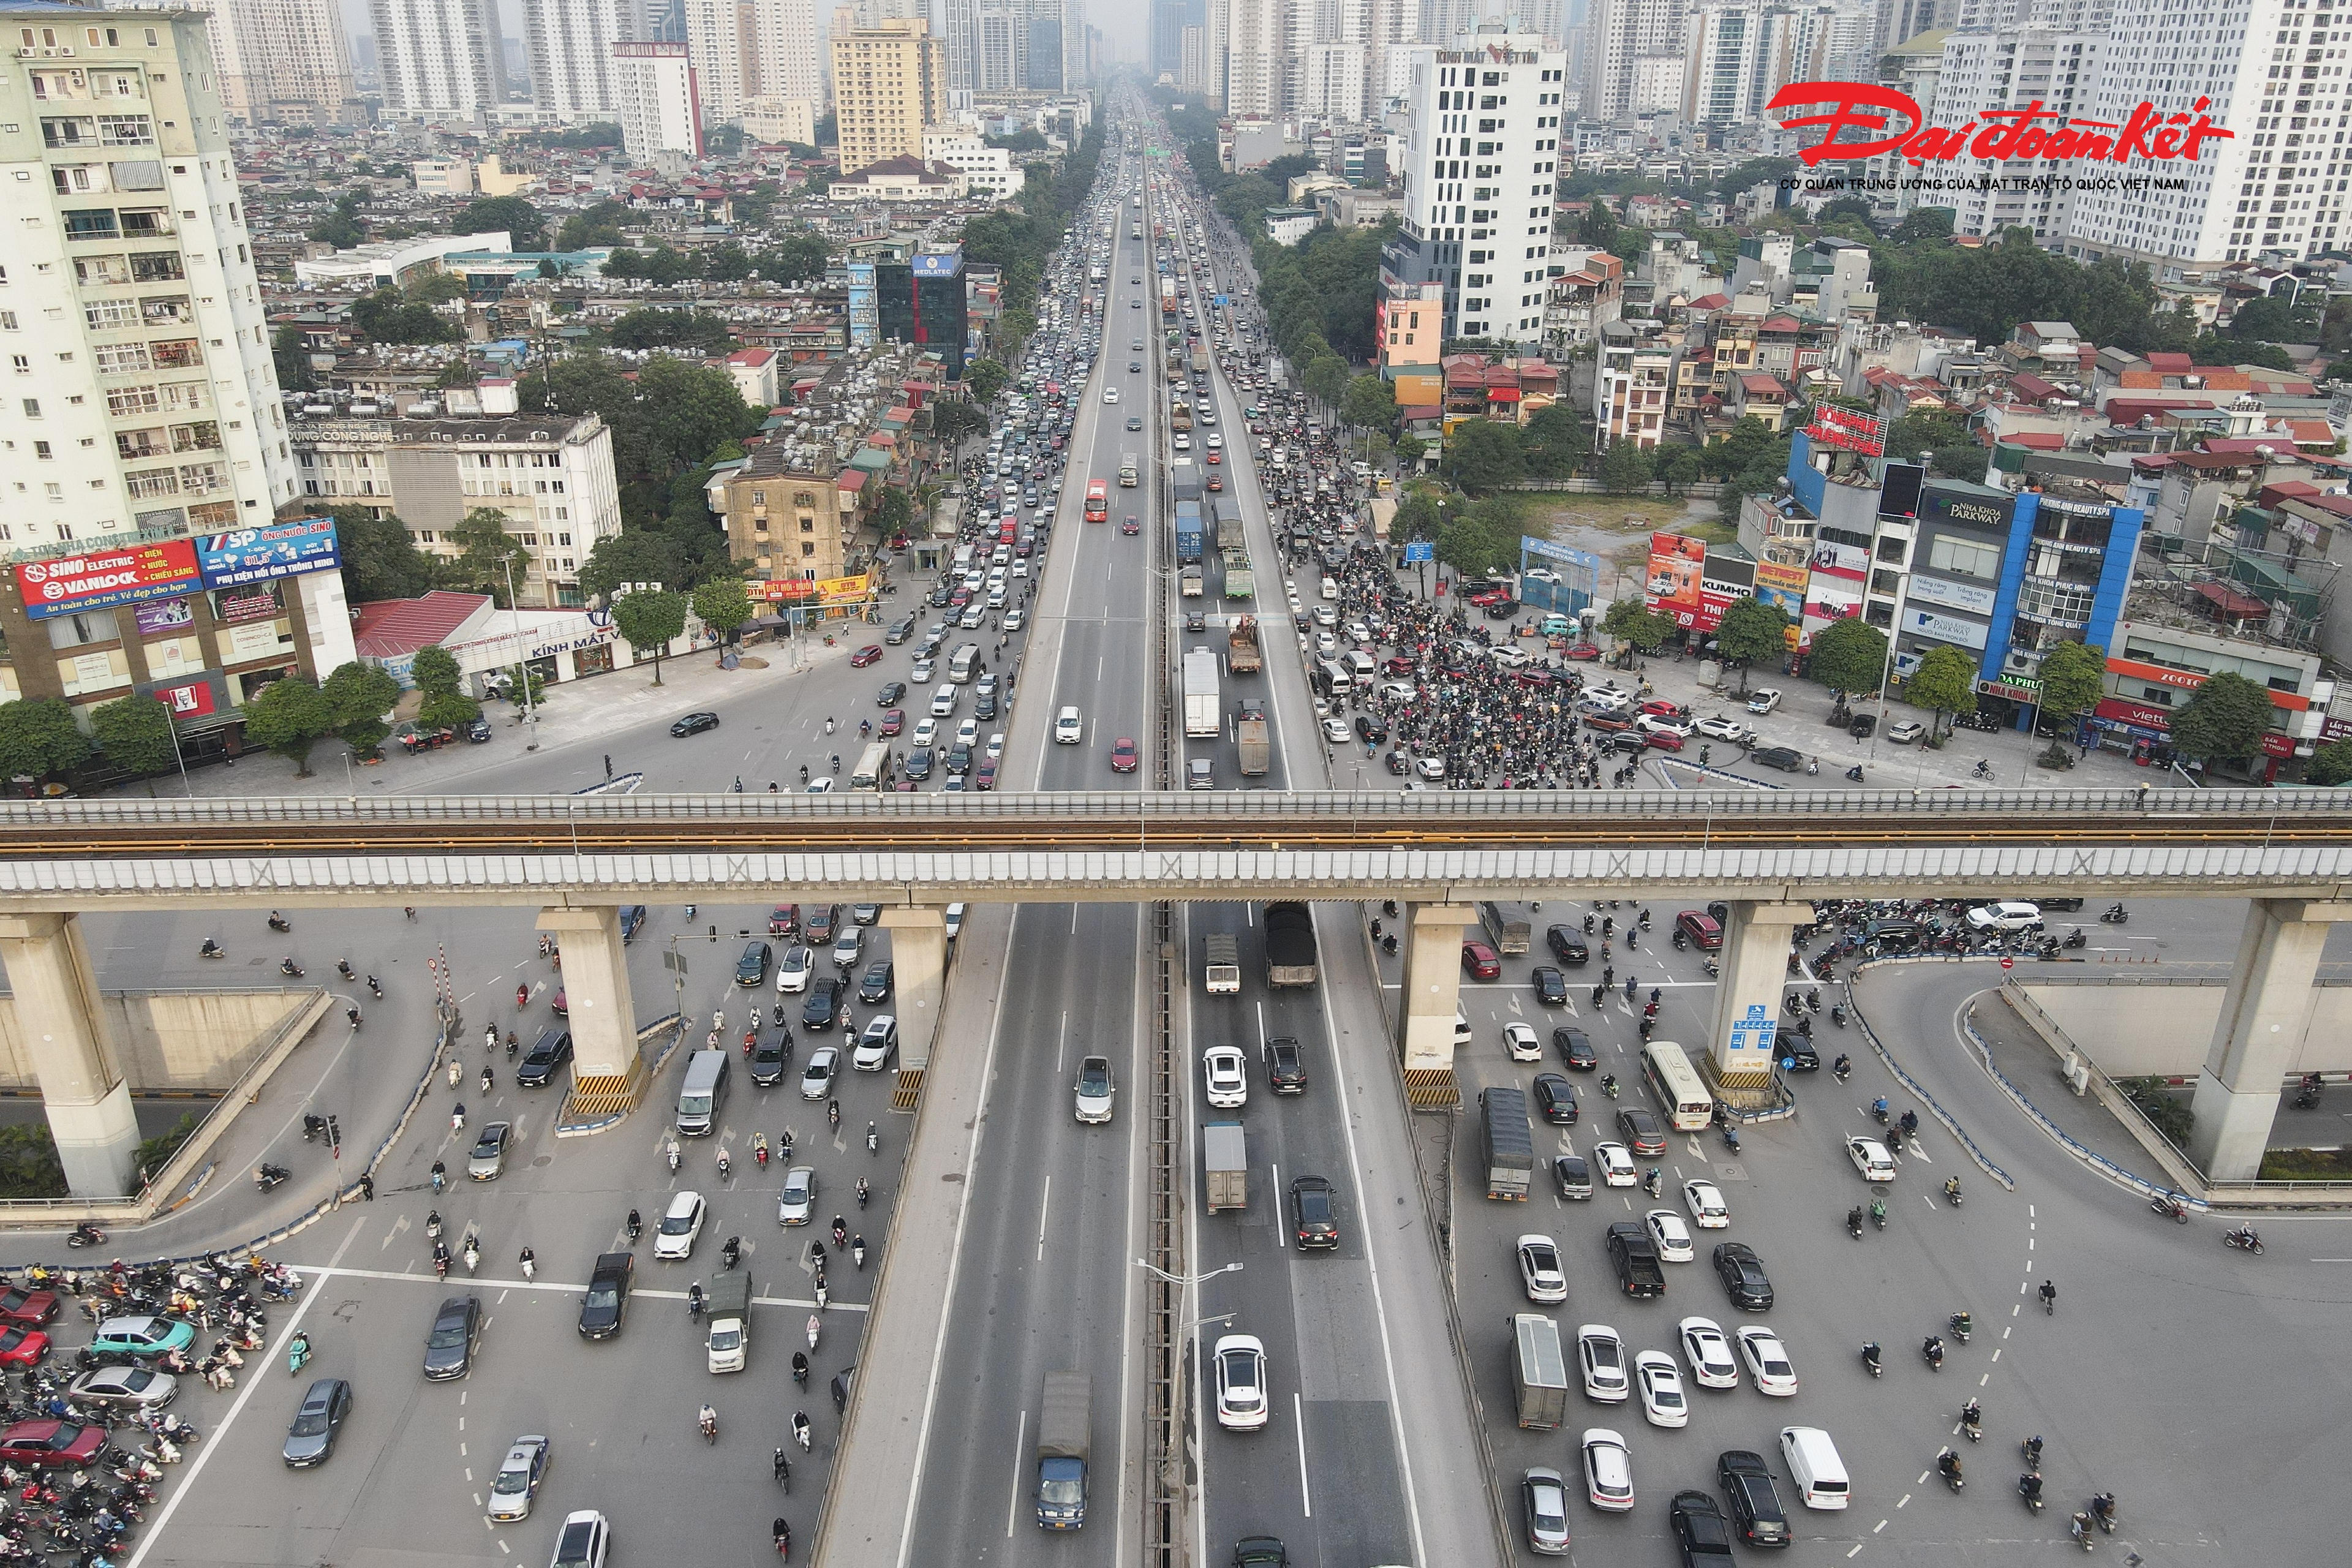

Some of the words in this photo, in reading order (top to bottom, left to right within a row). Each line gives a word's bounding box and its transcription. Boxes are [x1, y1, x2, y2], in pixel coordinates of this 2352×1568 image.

[1950, 504, 2002, 525] PARKWAY
[1959, 502, 1978, 513] NHA
[1978, 507, 2002, 517] KHOA
[2073, 504, 2098, 515] BEAUTY
[2097, 507, 2110, 516] SPA
[262, 529, 281, 541] ỐNG
[283, 526, 307, 539] NƯỚC
[309, 521, 332, 533] SINO
[2065, 544, 2089, 554] BEAUTY
[49, 558, 85, 578] SINO
[86, 556, 135, 571] ELECTRIC
[150, 568, 173, 581] CHIẾU
[173, 565, 194, 578] SÁNG
[216, 575, 233, 585] PHỤ
[235, 571, 254, 582] KIỆN
[255, 568, 269, 578] NỐI
[270, 565, 287, 576] ỐNG
[287, 560, 314, 573] THÔNG
[314, 557, 335, 568] MINH
[63, 570, 140, 594] VANLOCK
[1702, 581, 1751, 597] KUMHO
[2037, 578, 2054, 588] KHOA
[46, 604, 59, 613] An
[61, 600, 82, 611] toàn
[84, 597, 100, 608] cho
[133, 589, 151, 600] đẹp
[152, 586, 168, 595] cho
[170, 582, 187, 595] bạn
[1960, 595, 1982, 604] implant
[2018, 611, 2029, 620] NHA
[2030, 614, 2046, 624] KHOA
[1934, 619, 1971, 636] PARKWAY
[532, 643, 569, 658] KÍNH
[573, 631, 605, 649] MẮT
[2011, 648, 2023, 657] NHA
[2023, 651, 2041, 661] KHOA
[1989, 681, 2005, 696] NHA
[2007, 685, 2030, 701] KHOA
